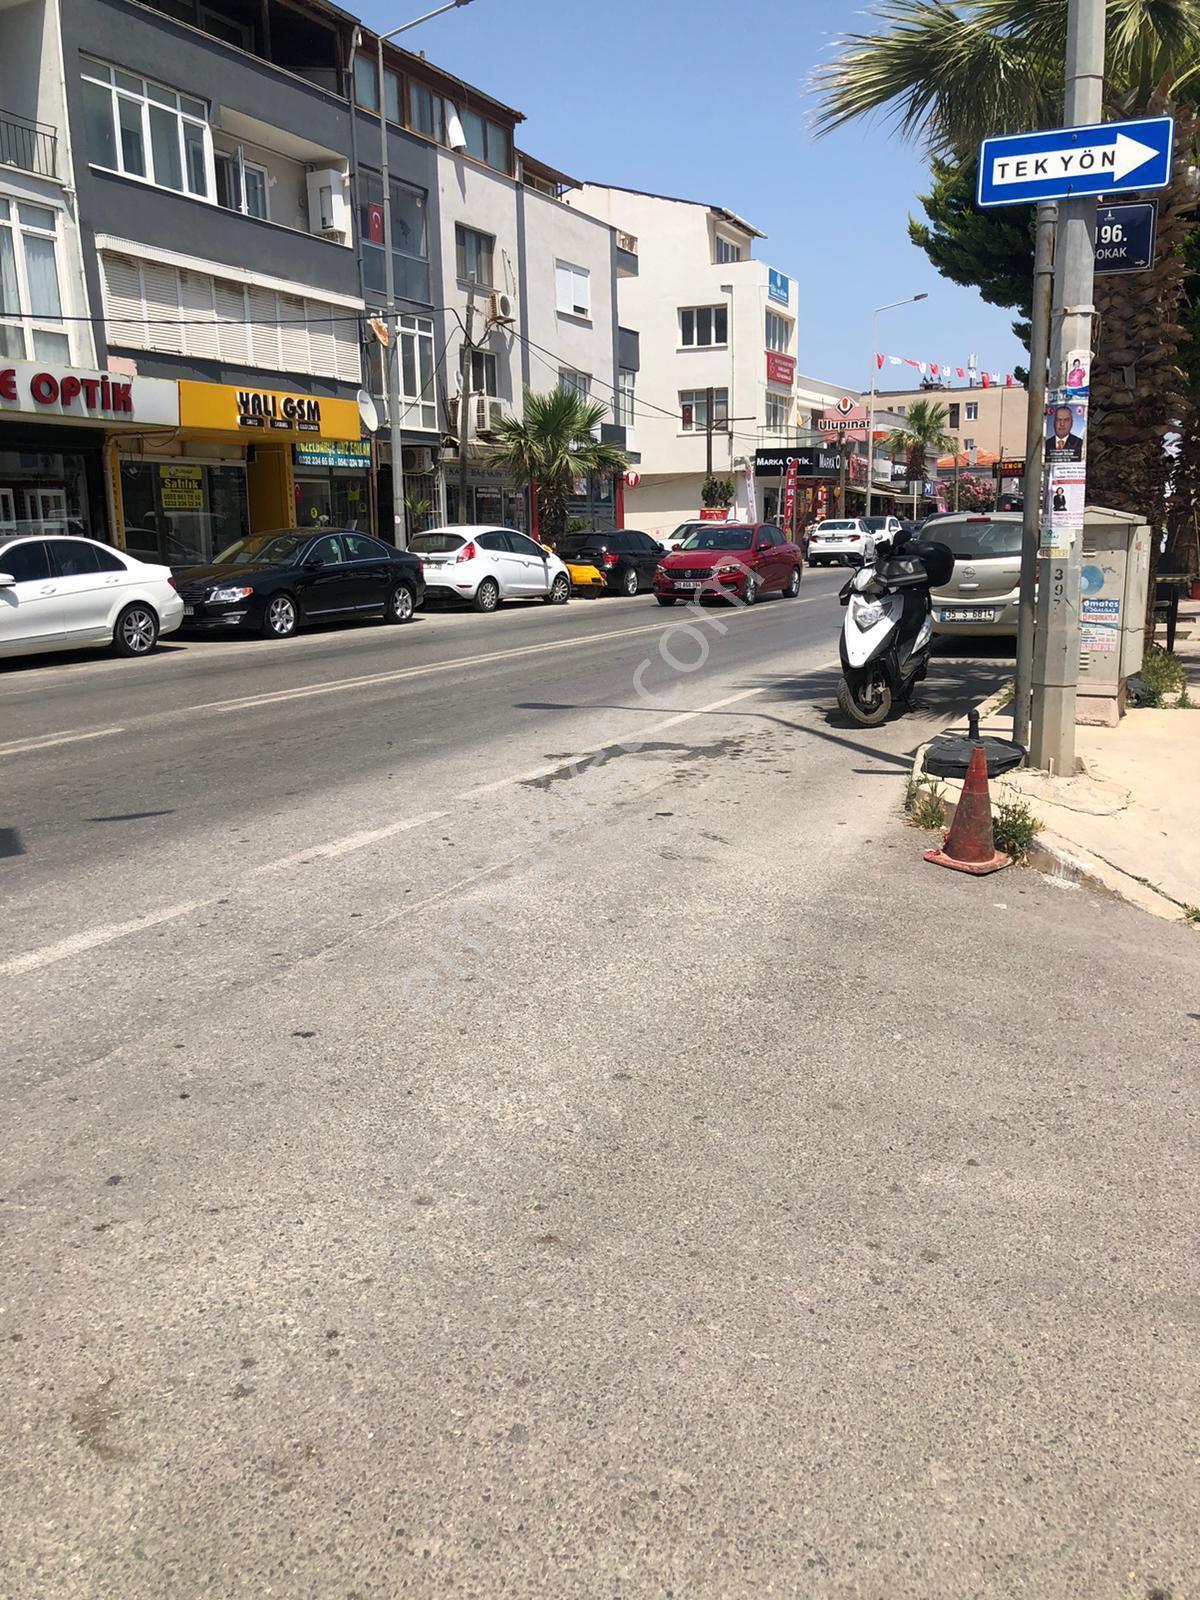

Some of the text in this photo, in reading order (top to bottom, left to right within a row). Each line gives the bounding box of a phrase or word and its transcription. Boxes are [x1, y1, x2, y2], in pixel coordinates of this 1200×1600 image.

[998, 150, 1115, 179] TEK YÖN
[1094, 247, 1127, 260] OKAK
[30, 372, 132, 412] OPTİK
[237, 391, 321, 421] YALI GSM
[757, 456, 809, 466] MARKA OTİK
